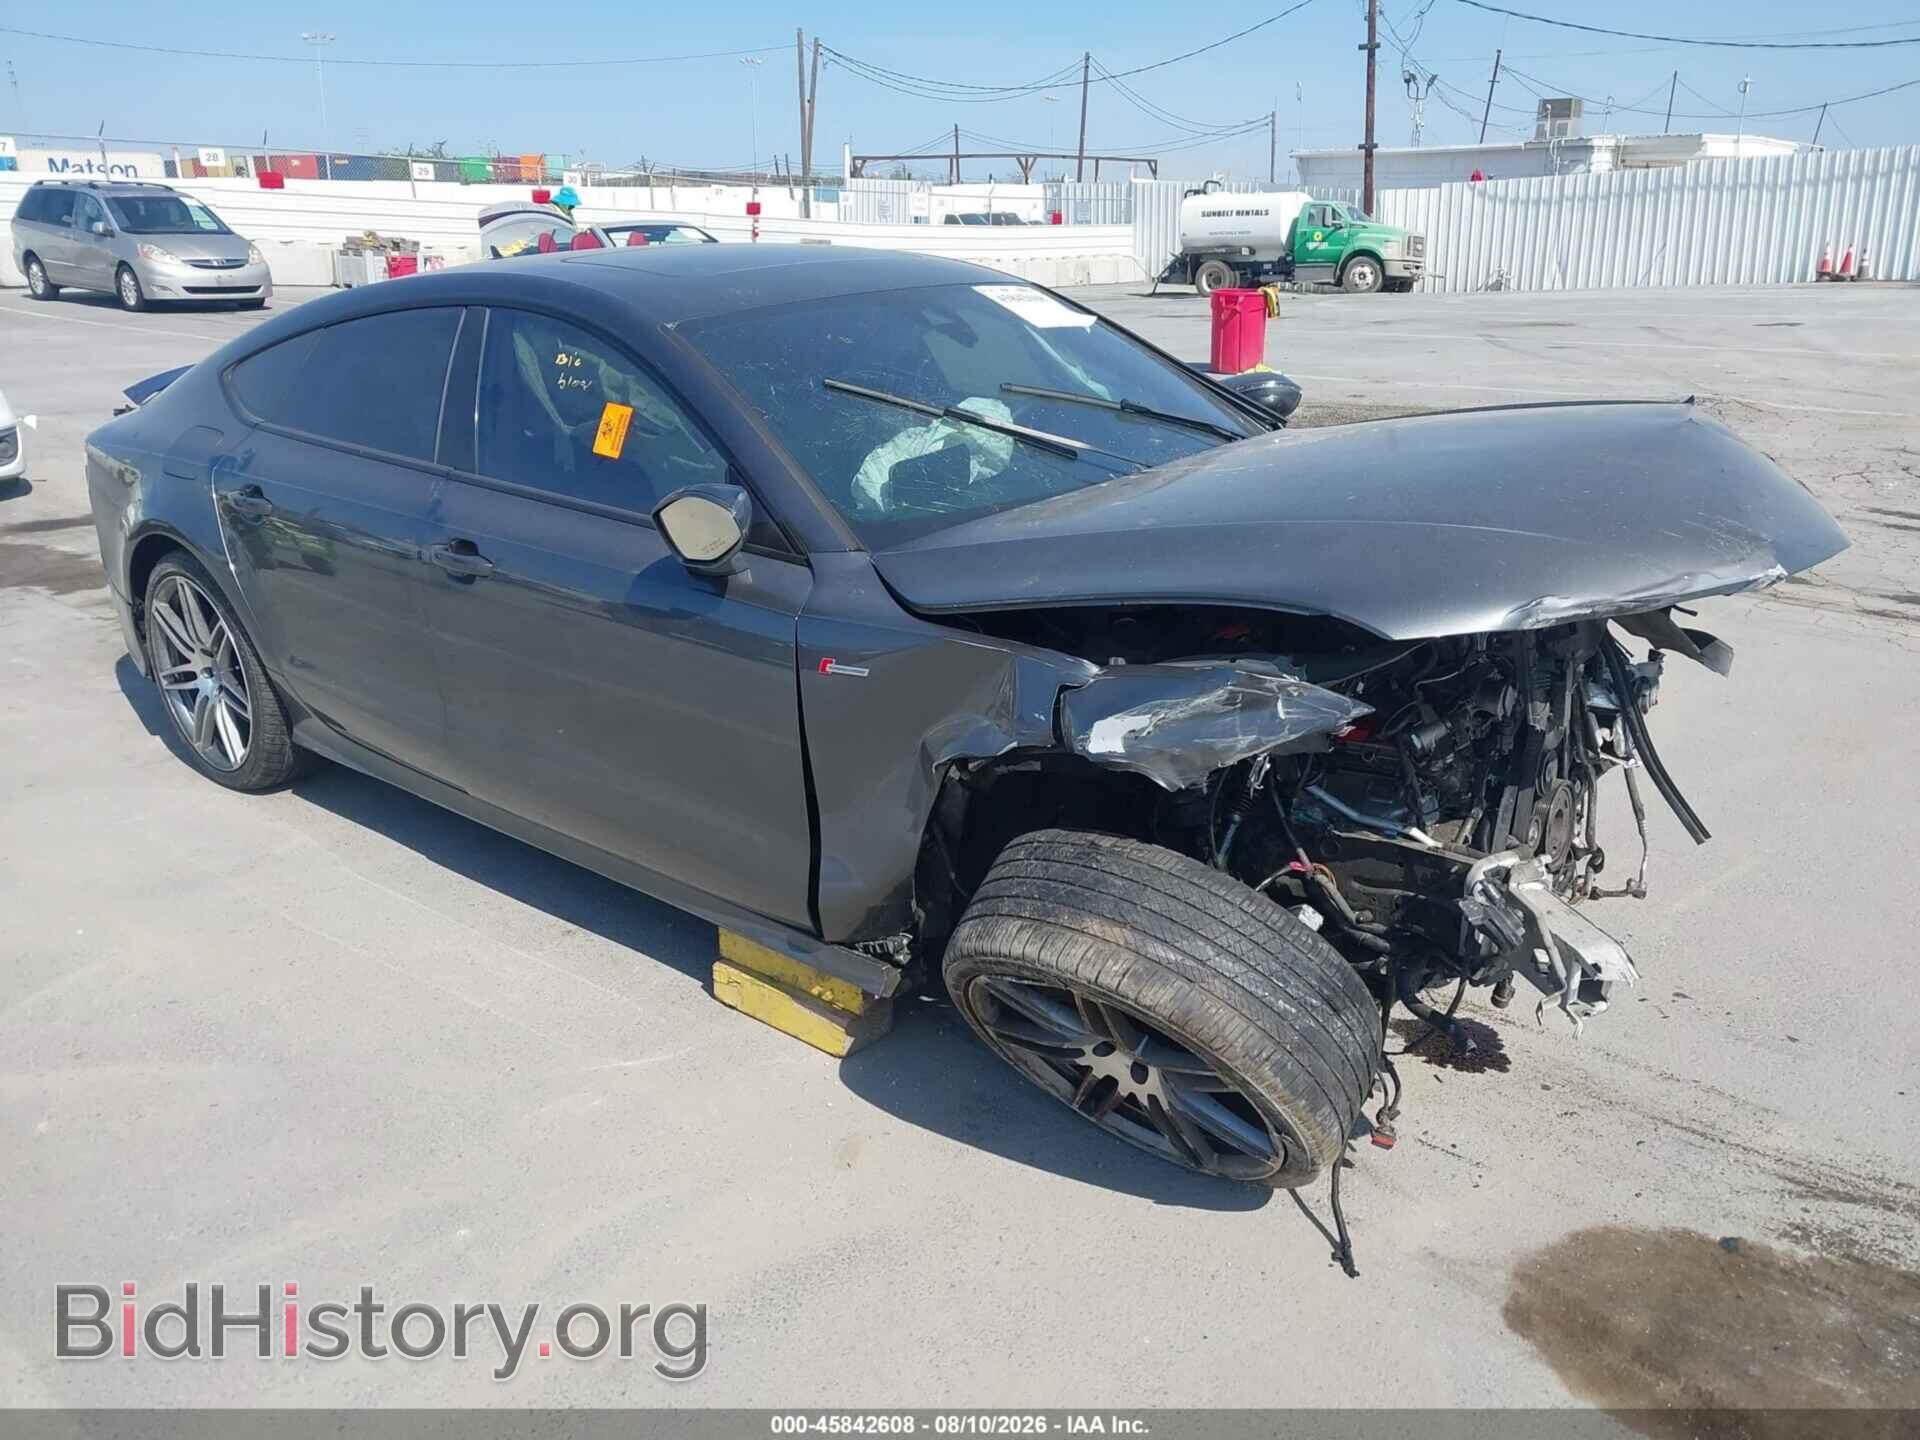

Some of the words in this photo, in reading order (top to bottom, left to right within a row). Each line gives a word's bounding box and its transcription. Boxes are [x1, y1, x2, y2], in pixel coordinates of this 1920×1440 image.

[47, 157, 139, 178] Matson
[1200, 209, 1234, 218] SUNBELT
[1235, 208, 1270, 217] RENTALS
